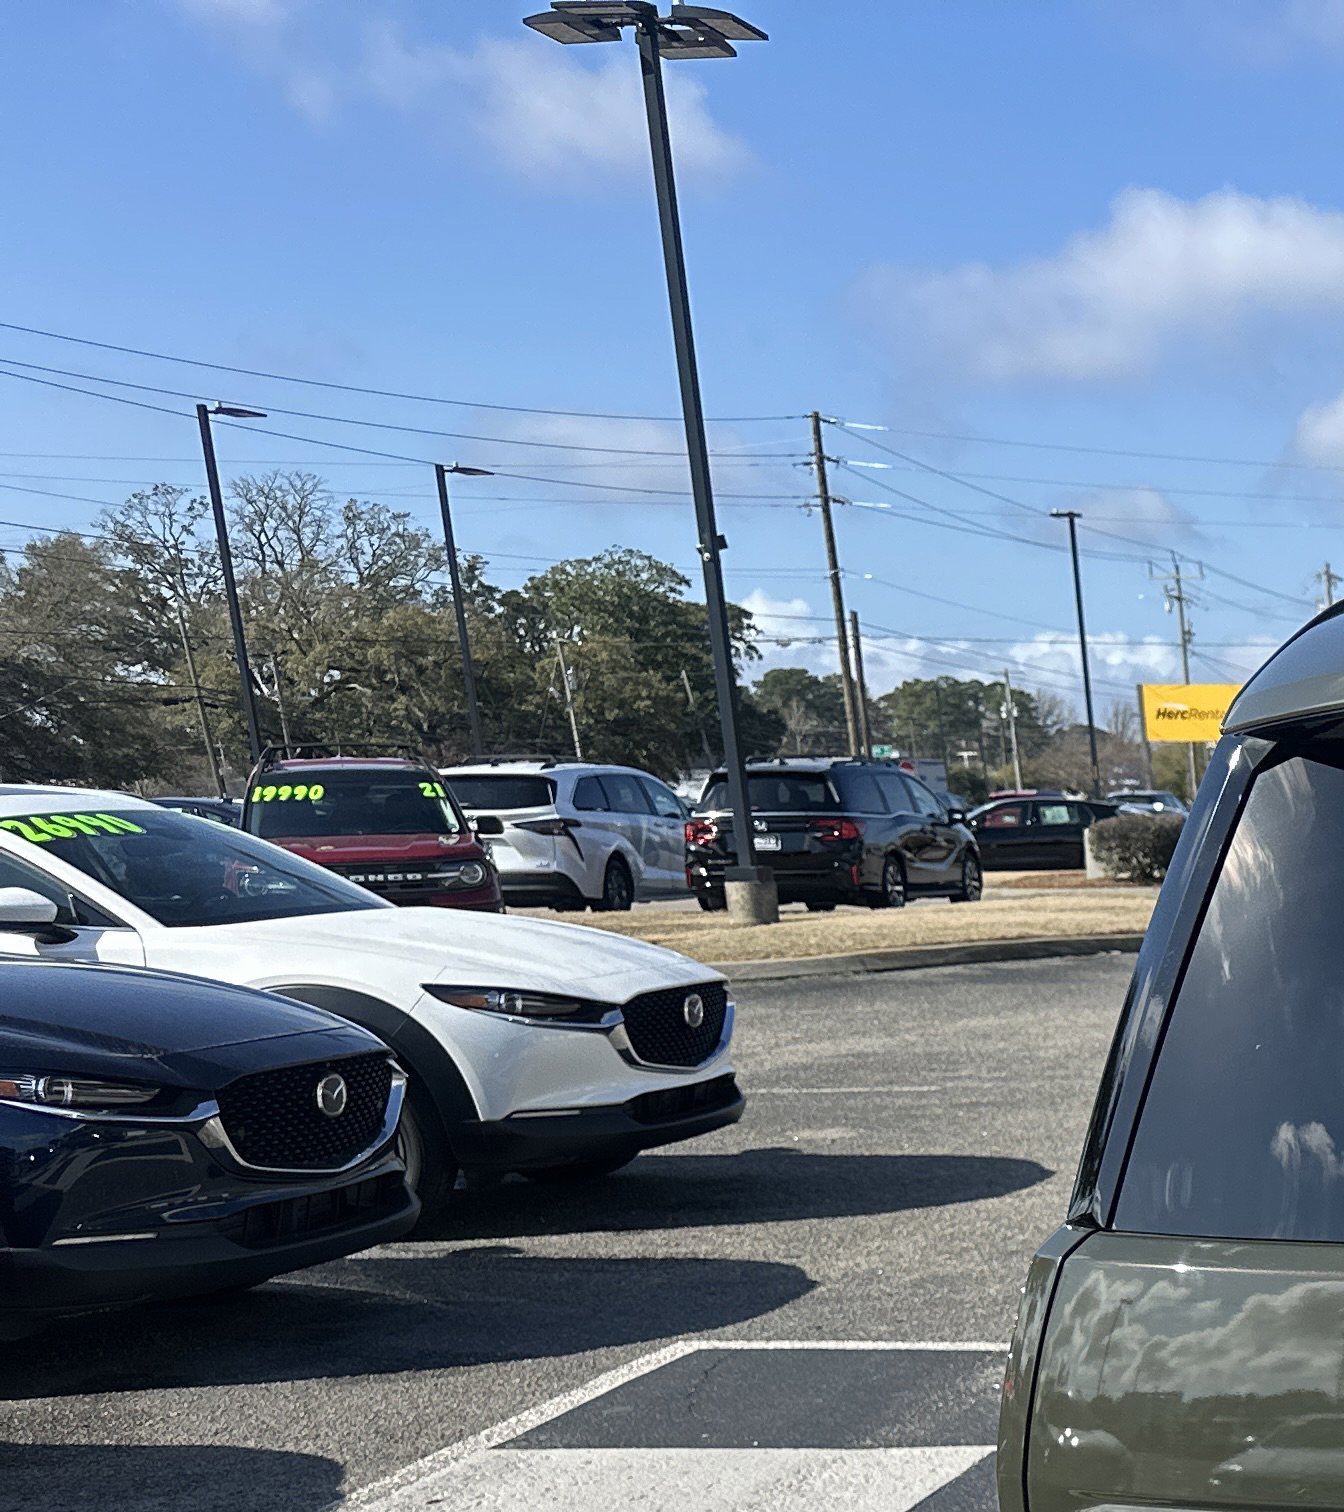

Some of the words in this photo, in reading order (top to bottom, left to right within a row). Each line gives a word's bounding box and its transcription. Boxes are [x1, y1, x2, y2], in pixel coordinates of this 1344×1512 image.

[252, 784, 325, 802] 19990
[418, 782, 447, 799] 21
[0, 813, 147, 842] 26990
